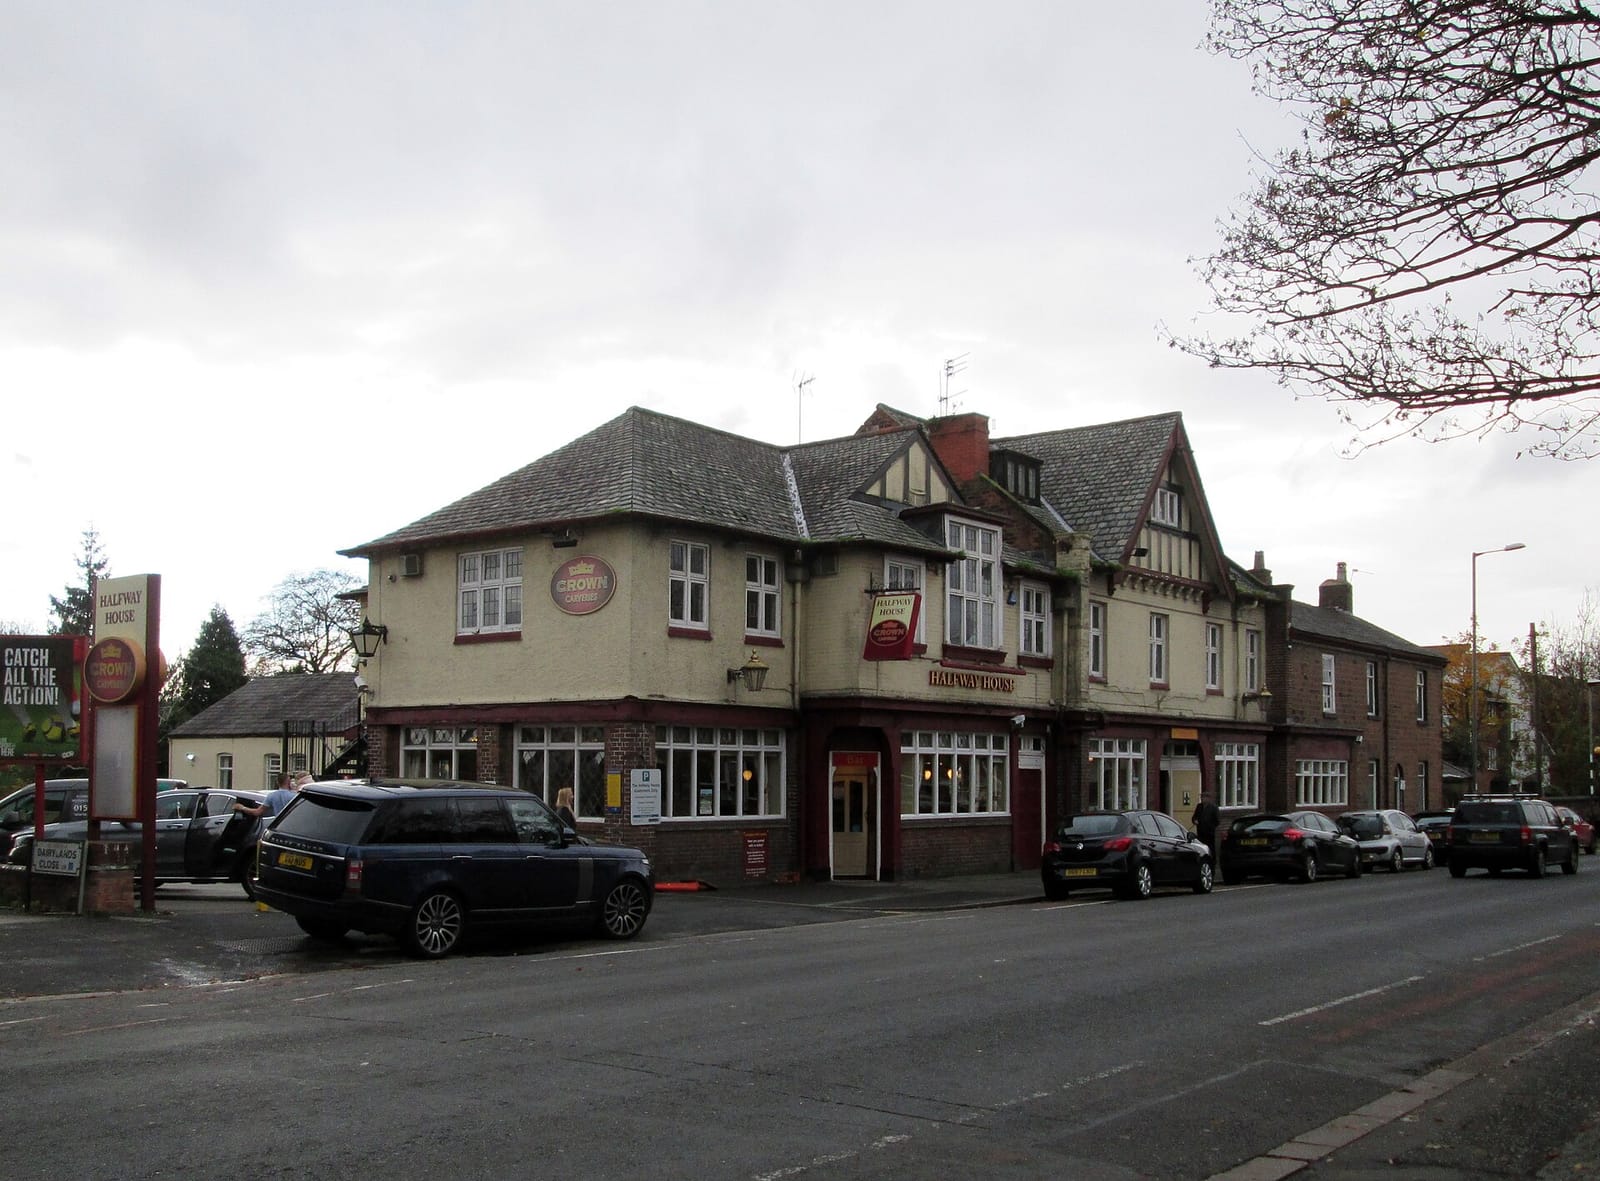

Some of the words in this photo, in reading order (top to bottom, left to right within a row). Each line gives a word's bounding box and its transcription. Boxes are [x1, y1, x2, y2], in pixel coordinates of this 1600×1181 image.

[556, 576, 608, 592] CROWN
[100, 590, 142, 608] HALFWAY
[876, 598, 912, 607] HALFWAY
[105, 610, 135, 625] HOUSE
[879, 608, 905, 616] HOUSE
[873, 628, 905, 637] CROWN
[4, 648, 49, 667] CATCH
[4, 667, 28, 686] ALL
[32, 667, 57, 686] THE
[929, 671, 979, 688] HALFWAY
[981, 676, 1015, 693] HOUSE
[3, 687, 59, 705] ACTION!
[37, 847, 77, 860] DAIRYLANDS
[39, 859, 60, 871] CLOSE
